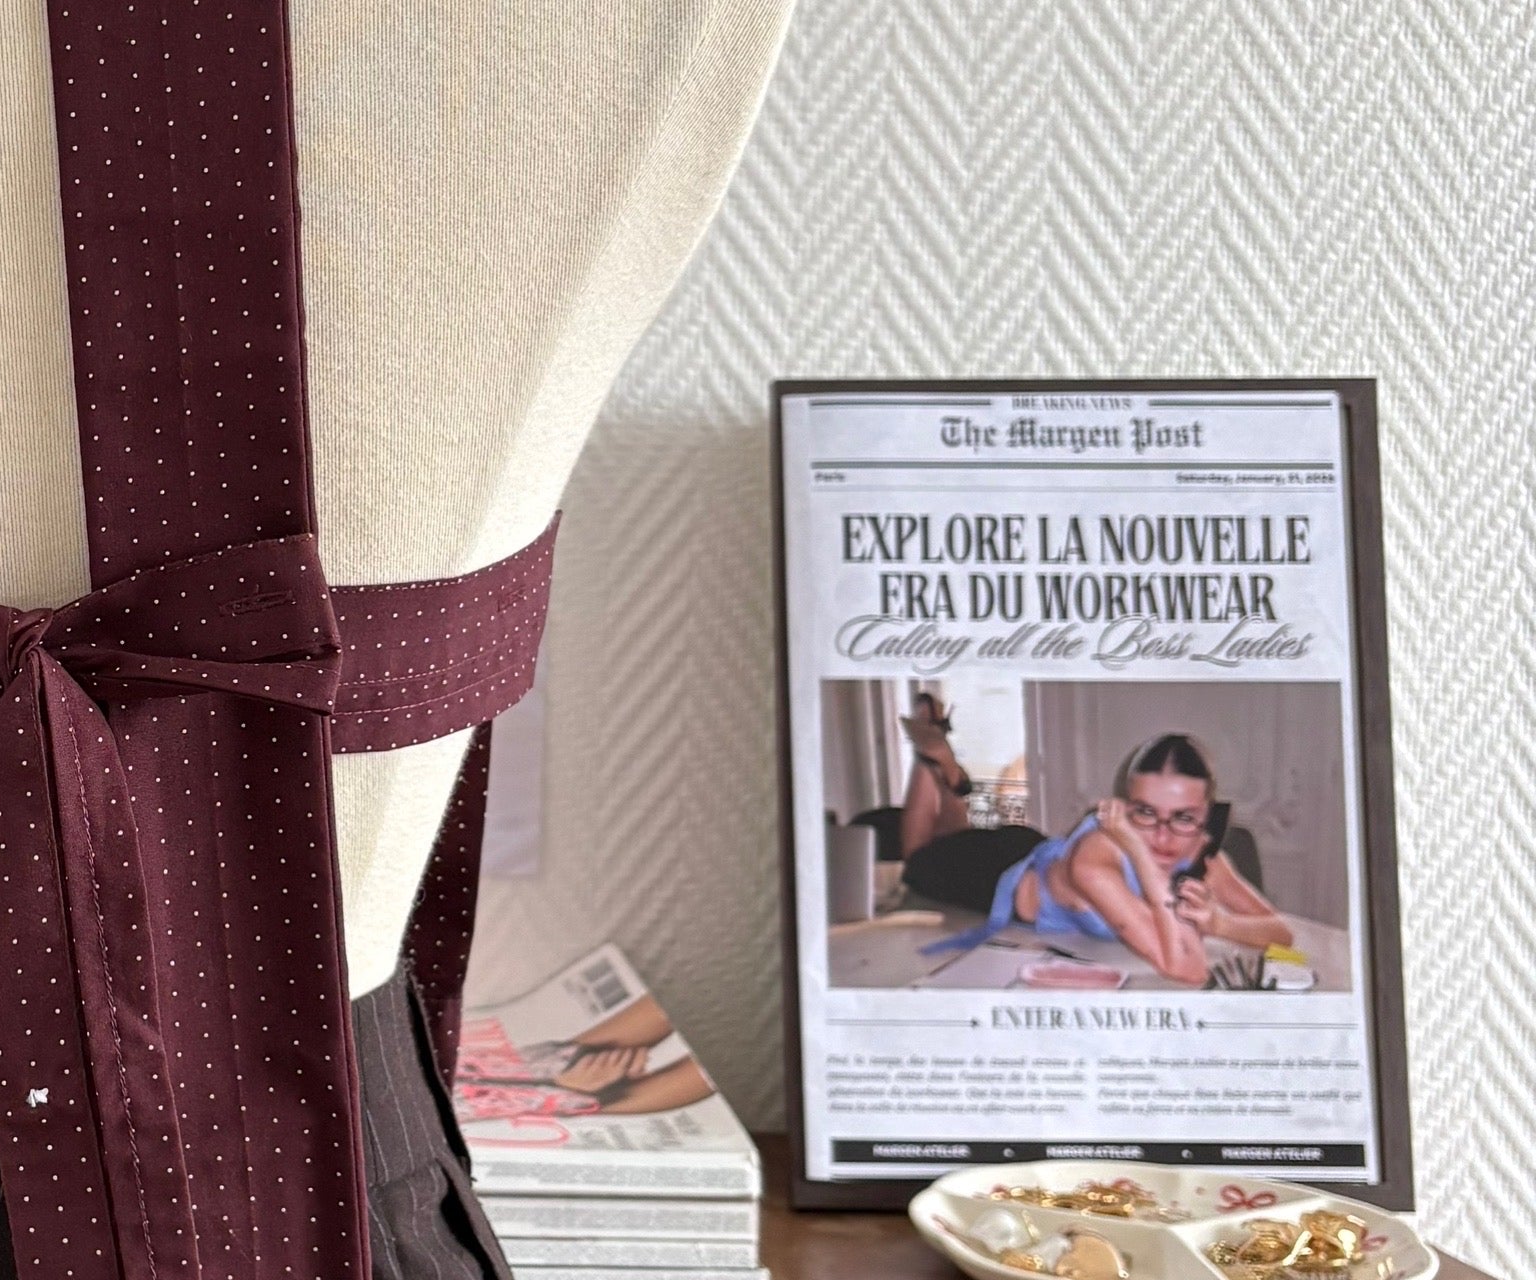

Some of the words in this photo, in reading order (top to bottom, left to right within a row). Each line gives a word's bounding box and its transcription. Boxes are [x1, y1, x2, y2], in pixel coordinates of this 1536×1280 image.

[939, 416, 997, 453] The
[1007, 417, 1122, 454] Margen
[1131, 417, 1206, 455] Post
[841, 514, 1026, 564] EXPLORE
[1038, 515, 1086, 565] LA
[1098, 515, 1311, 565] NOUVELLE
[878, 573, 955, 620] ERA
[968, 574, 1024, 621] DU
[1036, 574, 1277, 623] WORKWEAR
[835, 615, 971, 675] Calling
[977, 623, 1032, 659] all
[1030, 623, 1086, 660] the
[1091, 615, 1192, 670] Boss
[1190, 616, 1310, 667] Ladies
